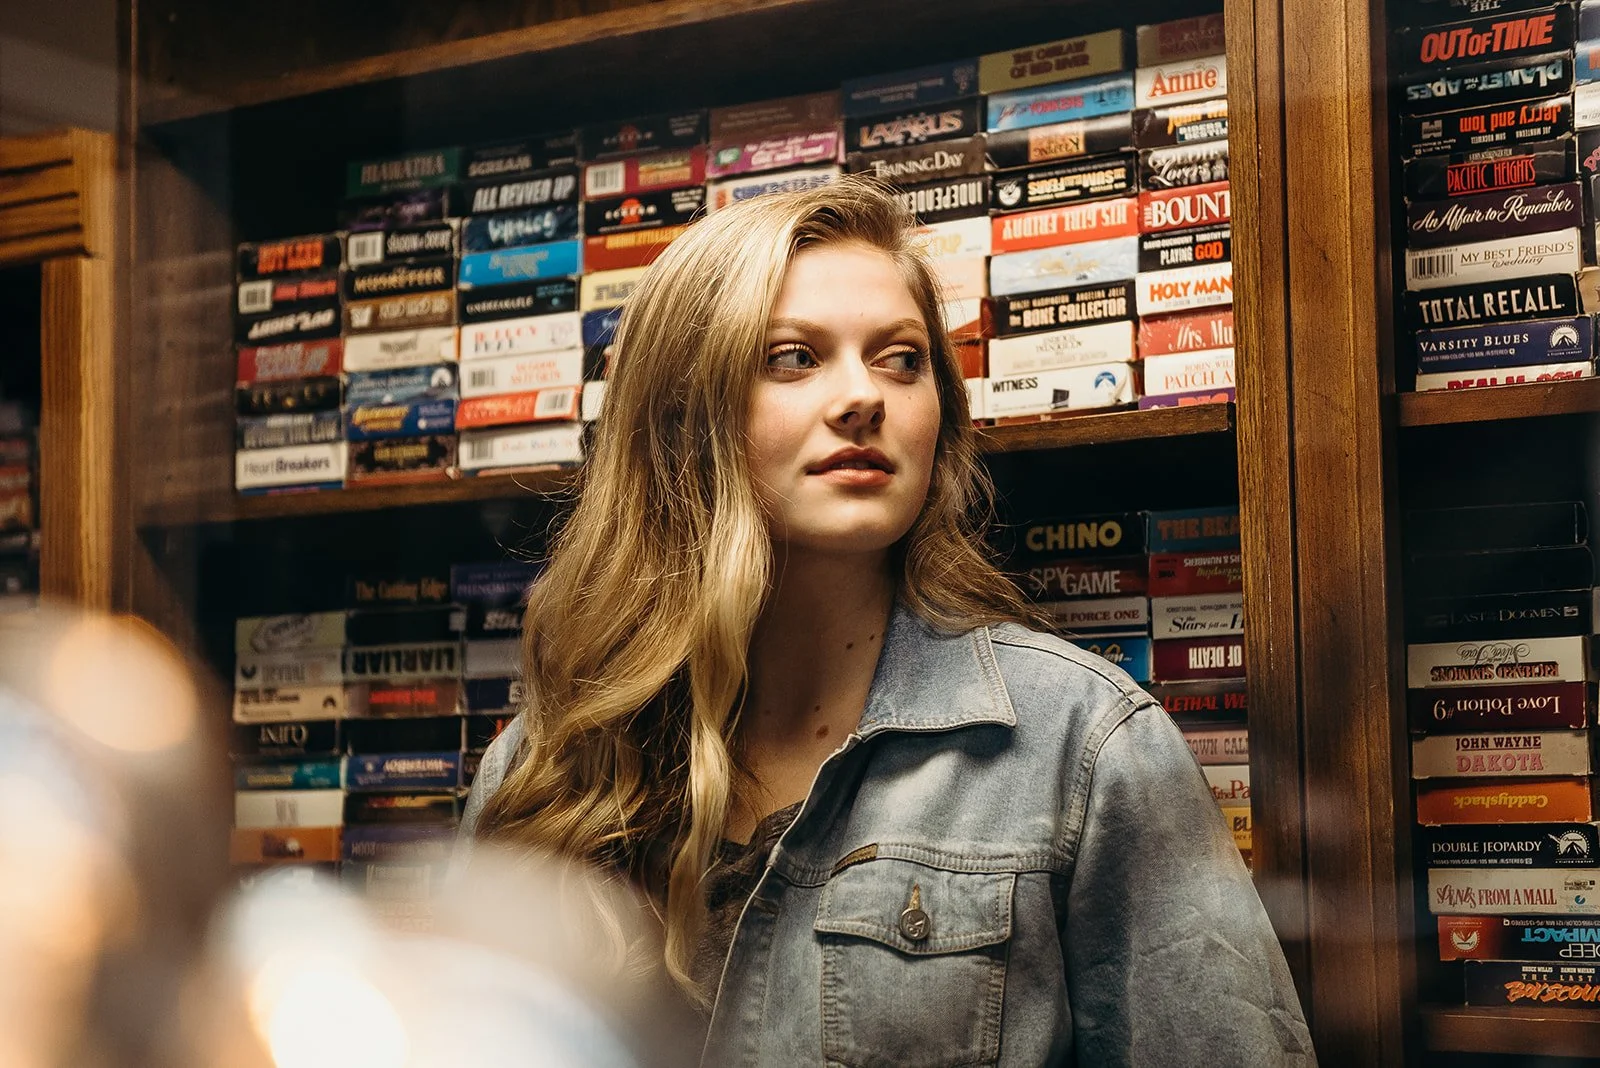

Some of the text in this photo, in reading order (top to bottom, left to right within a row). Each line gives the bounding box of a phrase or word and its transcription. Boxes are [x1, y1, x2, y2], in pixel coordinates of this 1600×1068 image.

[1420, 14, 1556, 63] OUT OF TIME
[1148, 67, 1218, 98] Annie
[1478, 59, 1563, 90] PLANET
[1406, 76, 1463, 100] APES
[1460, 104, 1562, 133] Jerry and Tom
[871, 150, 964, 178] TRAINING DAY
[1447, 158, 1536, 191] PACIFIC HEIGHTS
[1082, 169, 1115, 188] SUM
[472, 186, 499, 212] ALL
[552, 174, 576, 200] UP
[1151, 190, 1231, 228] BOUNT
[1412, 190, 1574, 232] An Affair to Remember
[1002, 203, 1127, 240] HIS GIRL FRIDAY
[1160, 241, 1224, 266] PLAYING GOD
[1460, 242, 1574, 263] MY BEST FRIEND'S
[1491, 255, 1544, 269] Wedding
[1150, 275, 1232, 302] HOLY MAN
[1023, 306, 1055, 328] BONE
[1058, 297, 1127, 323] COLLECTOR
[1419, 285, 1562, 324] TOTAL RECALL
[1168, 320, 1233, 351] Mrs. Mu
[1419, 333, 1529, 352] VARSITY BLUES
[1215, 359, 1234, 369] WIL
[992, 377, 1038, 393] WITNESS
[1164, 371, 1234, 390] PATCH A
[1025, 520, 1122, 551] CHINO
[1157, 516, 1240, 540] THE BEA
[1030, 566, 1121, 596] SPY GAME
[1071, 611, 1111, 622] FORCE
[1114, 610, 1140, 620] ONE
[1169, 616, 1207, 633] Stars
[1189, 645, 1242, 670] OF DEATH
[1430, 661, 1559, 682] RICHARD SIMMONS
[1164, 693, 1247, 712] LETHAL WE
[1457, 697, 1513, 716] Potion
[1517, 695, 1561, 714] Love
[1456, 735, 1542, 751] JOHN WAYNE
[1456, 753, 1544, 773] DAKOTA
[1230, 780, 1251, 799] Pa
[1453, 792, 1548, 810] Caddyshack
[1432, 841, 1542, 854] DOUBLE JEOPARDY
[1478, 888, 1512, 905] FROM
[1513, 888, 1522, 905] A
[1523, 888, 1557, 905] MALL
[1521, 928, 1600, 943] MPACT
